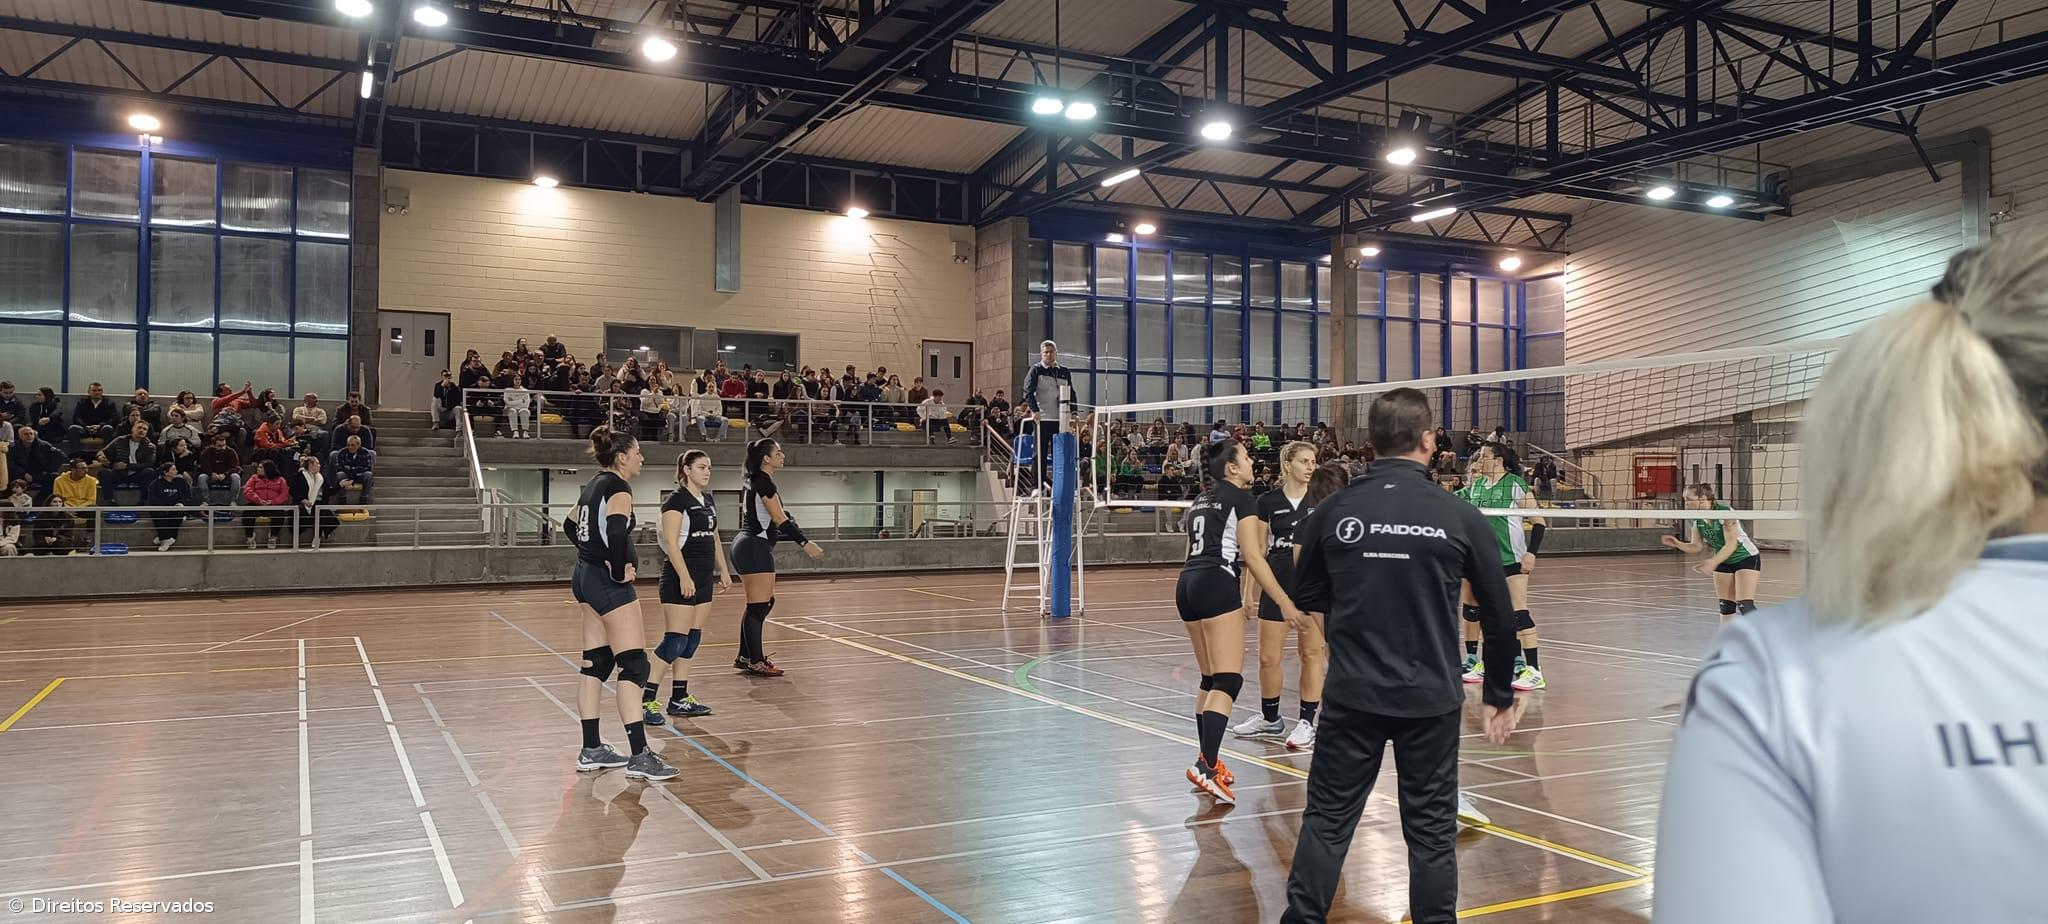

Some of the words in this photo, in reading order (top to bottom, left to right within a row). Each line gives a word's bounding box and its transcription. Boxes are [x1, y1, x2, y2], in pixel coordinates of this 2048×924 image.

[1190, 515, 1205, 556] 3
[1369, 523, 1448, 540] FAIDOCA
[1936, 722, 2045, 768] ILH
